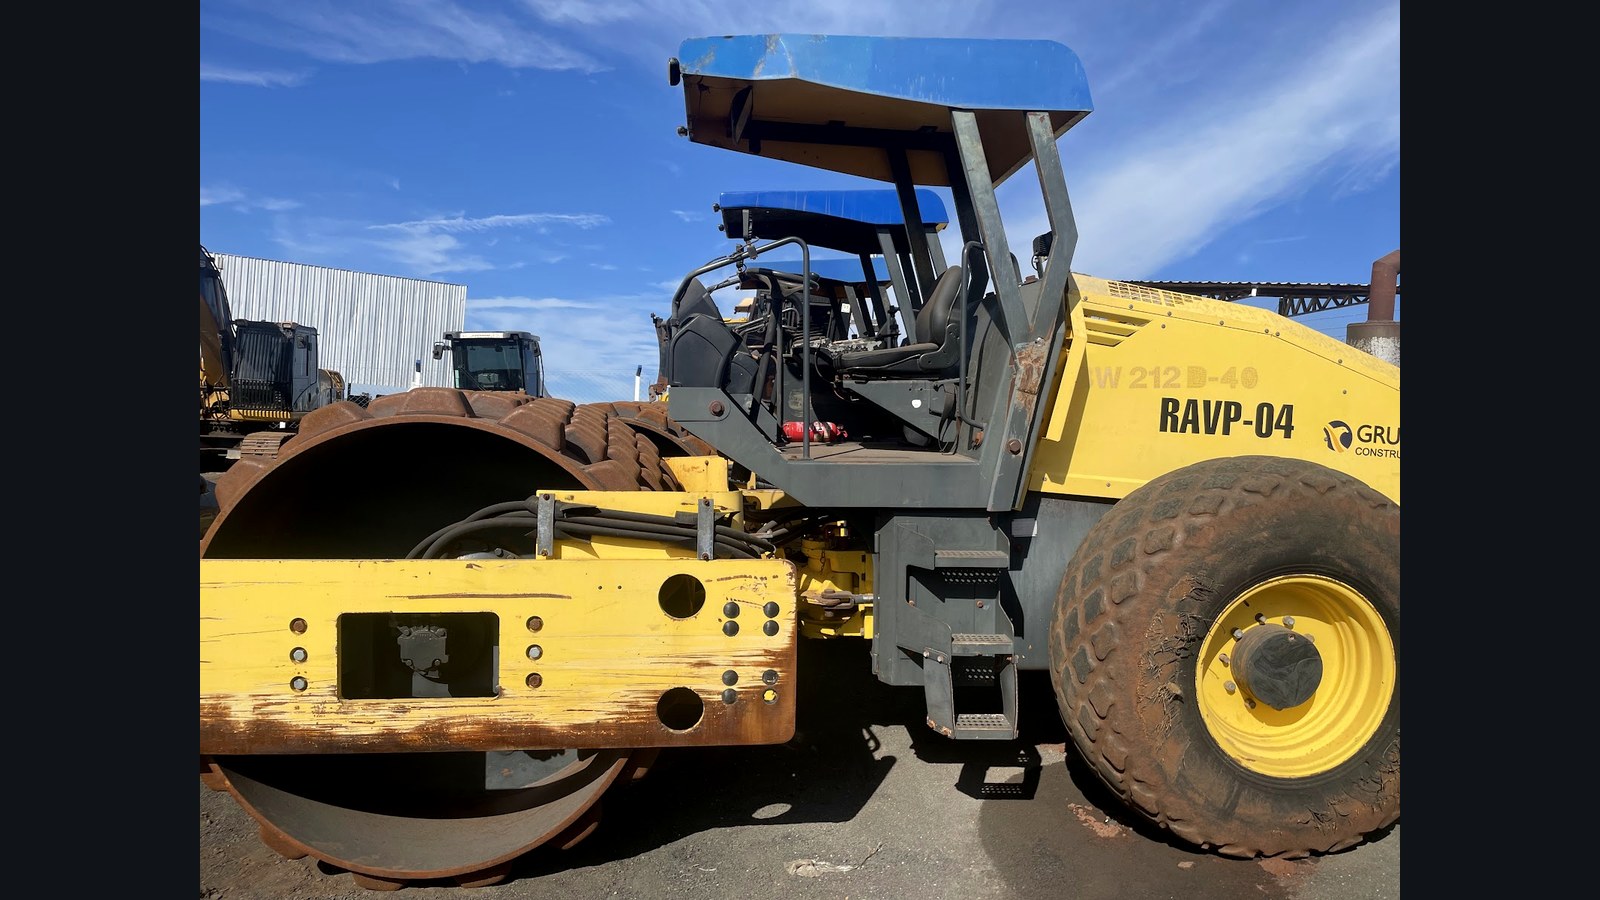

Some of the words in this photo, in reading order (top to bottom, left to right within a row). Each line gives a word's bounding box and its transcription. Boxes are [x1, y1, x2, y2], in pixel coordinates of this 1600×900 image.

[1089, 366, 1122, 389] W
[1129, 366, 1181, 389] 212
[1187, 366, 1258, 389] D-40
[1159, 397, 1294, 439] RAVP-04
[1357, 424, 1400, 445] GRU
